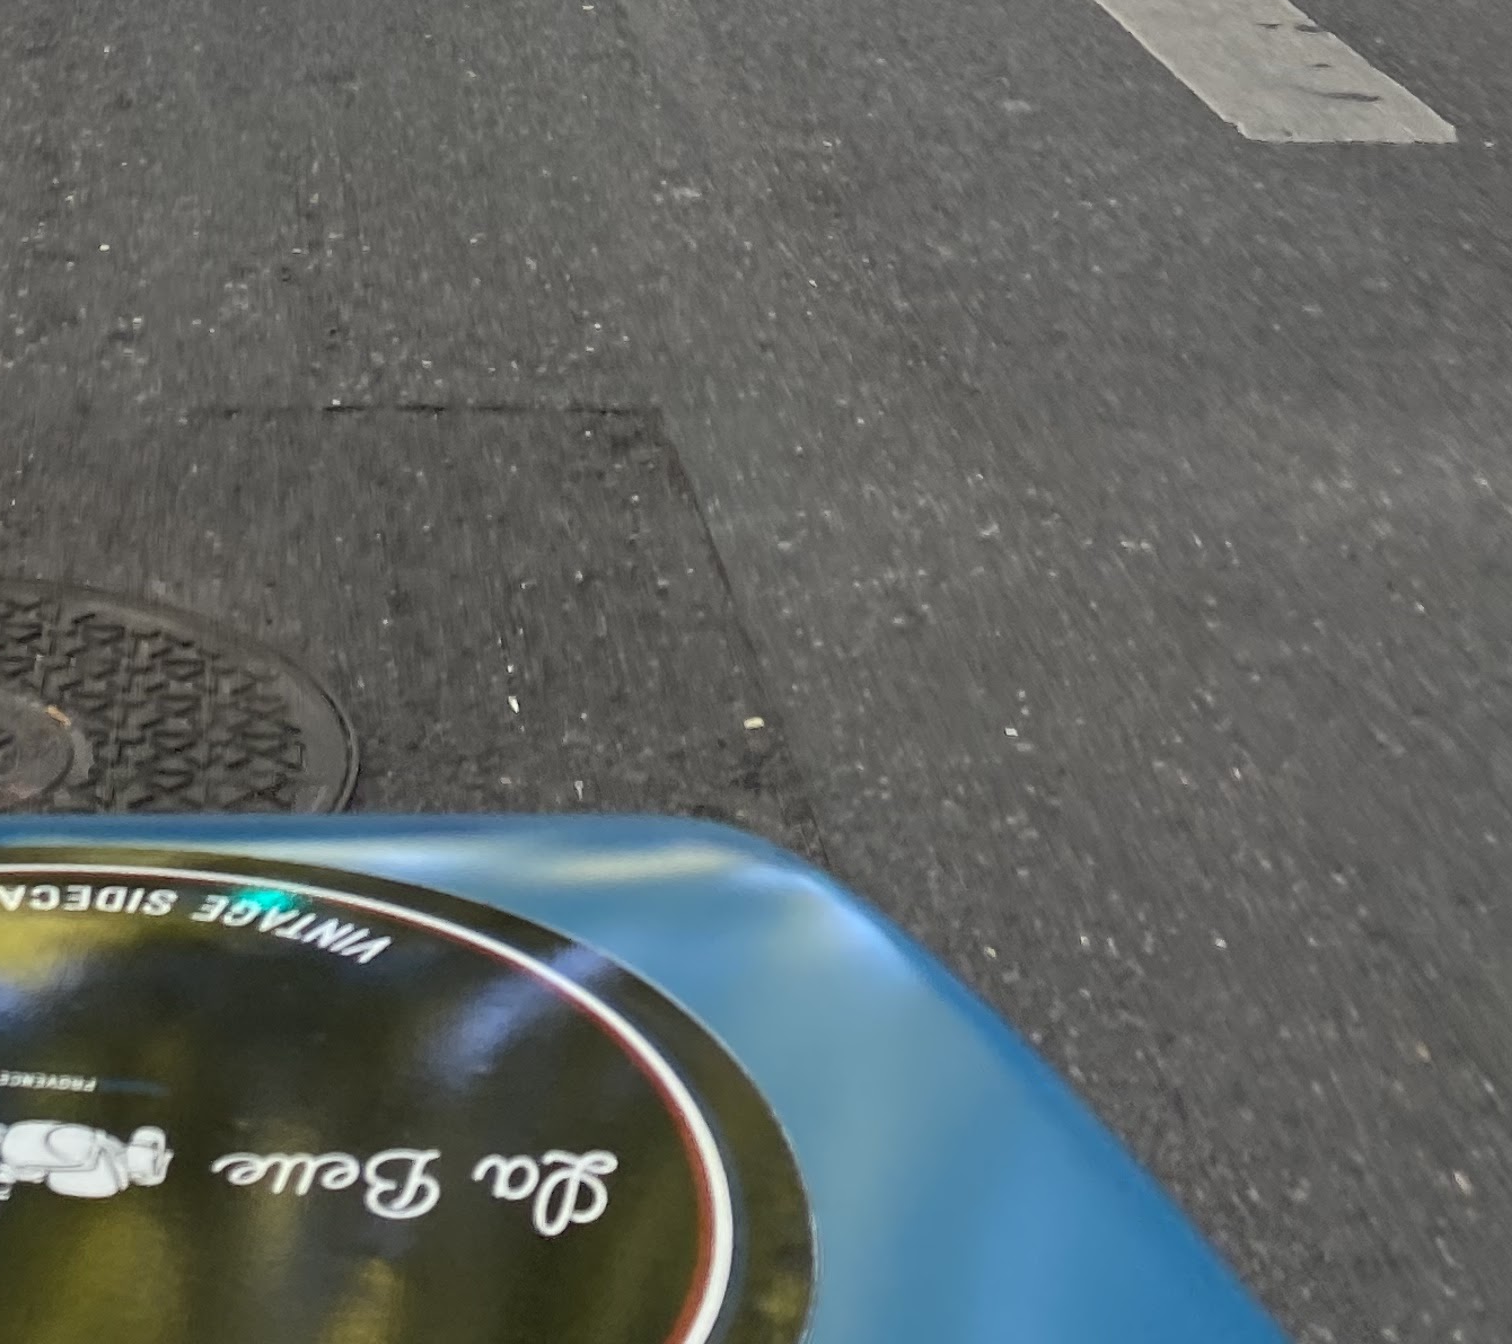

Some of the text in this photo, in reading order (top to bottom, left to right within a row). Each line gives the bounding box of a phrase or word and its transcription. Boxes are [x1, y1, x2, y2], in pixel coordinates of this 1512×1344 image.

[191, 894, 392, 965] VINTAGE
[210, 1148, 441, 1219] Belle
[471, 1149, 619, 1237] La
